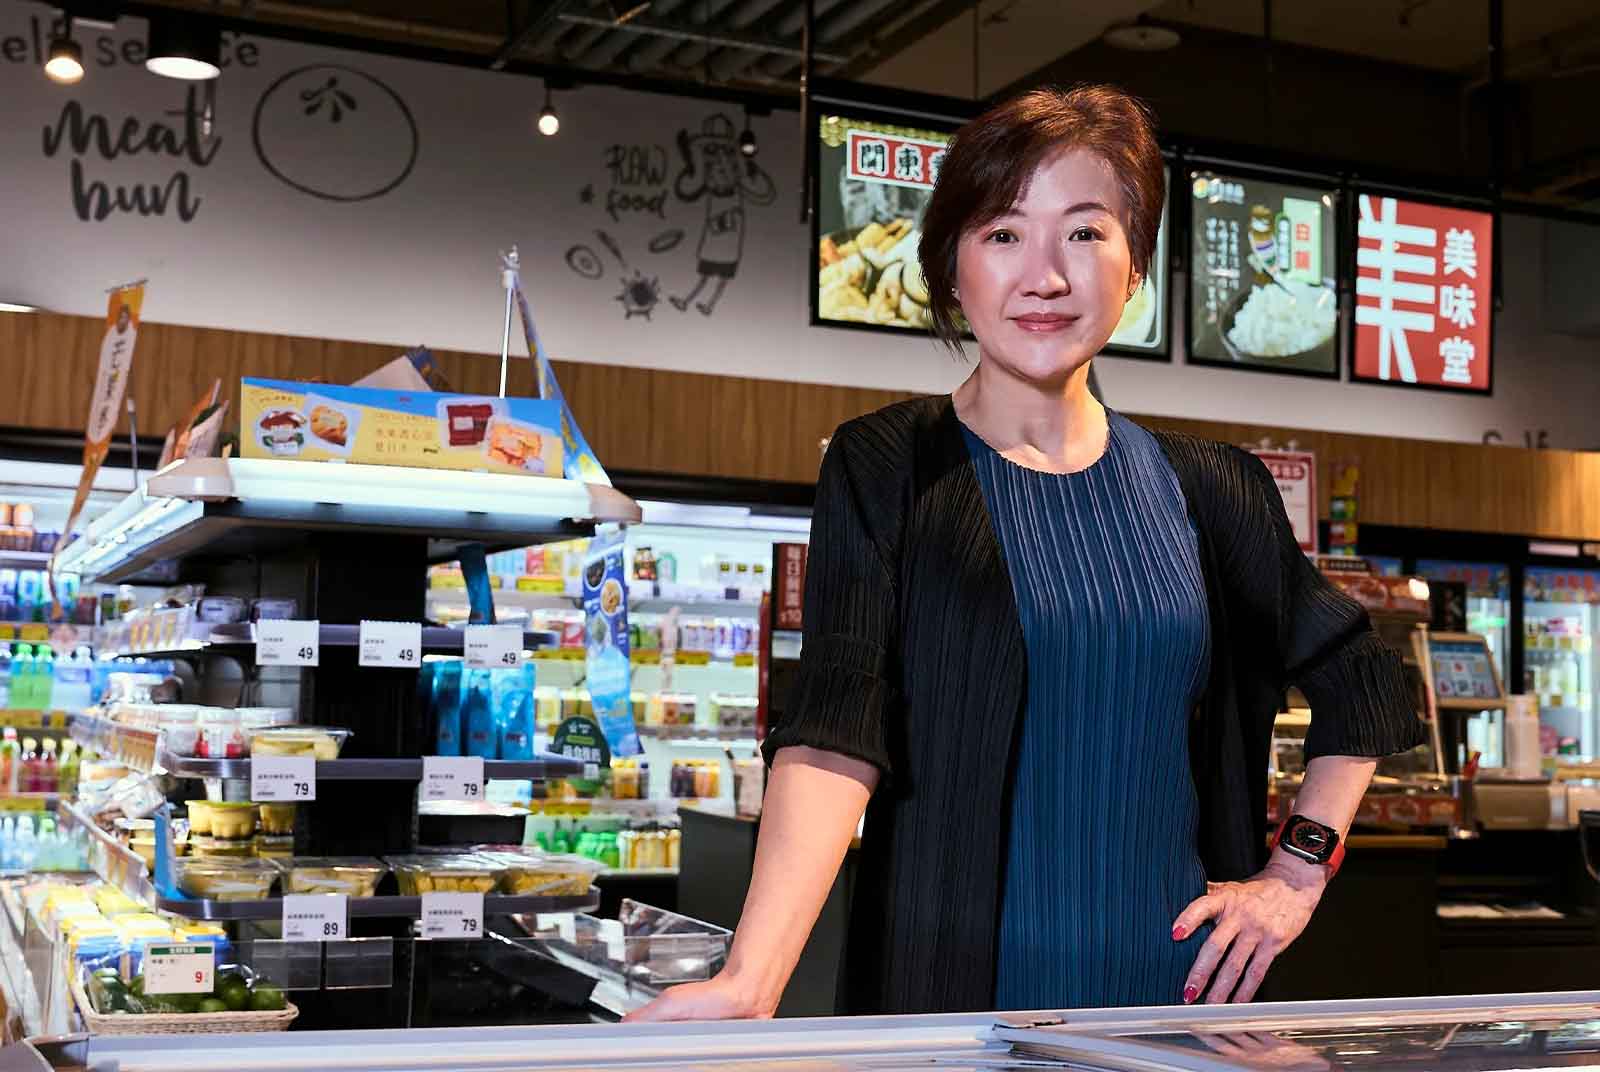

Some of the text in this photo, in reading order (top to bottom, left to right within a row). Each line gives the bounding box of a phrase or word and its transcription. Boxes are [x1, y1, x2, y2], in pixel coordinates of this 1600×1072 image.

[70, 158, 202, 222] bun
[606, 187, 667, 223] food
[1439, 227, 1477, 384] 美味堂
[297, 647, 314, 660] 49
[398, 649, 414, 662] 49
[501, 652, 516, 664] 49
[293, 783, 309, 796] 79
[463, 783, 479, 796] 79
[323, 922, 339, 936] 89
[462, 919, 477, 932] 79
[195, 971, 203, 983] 9
